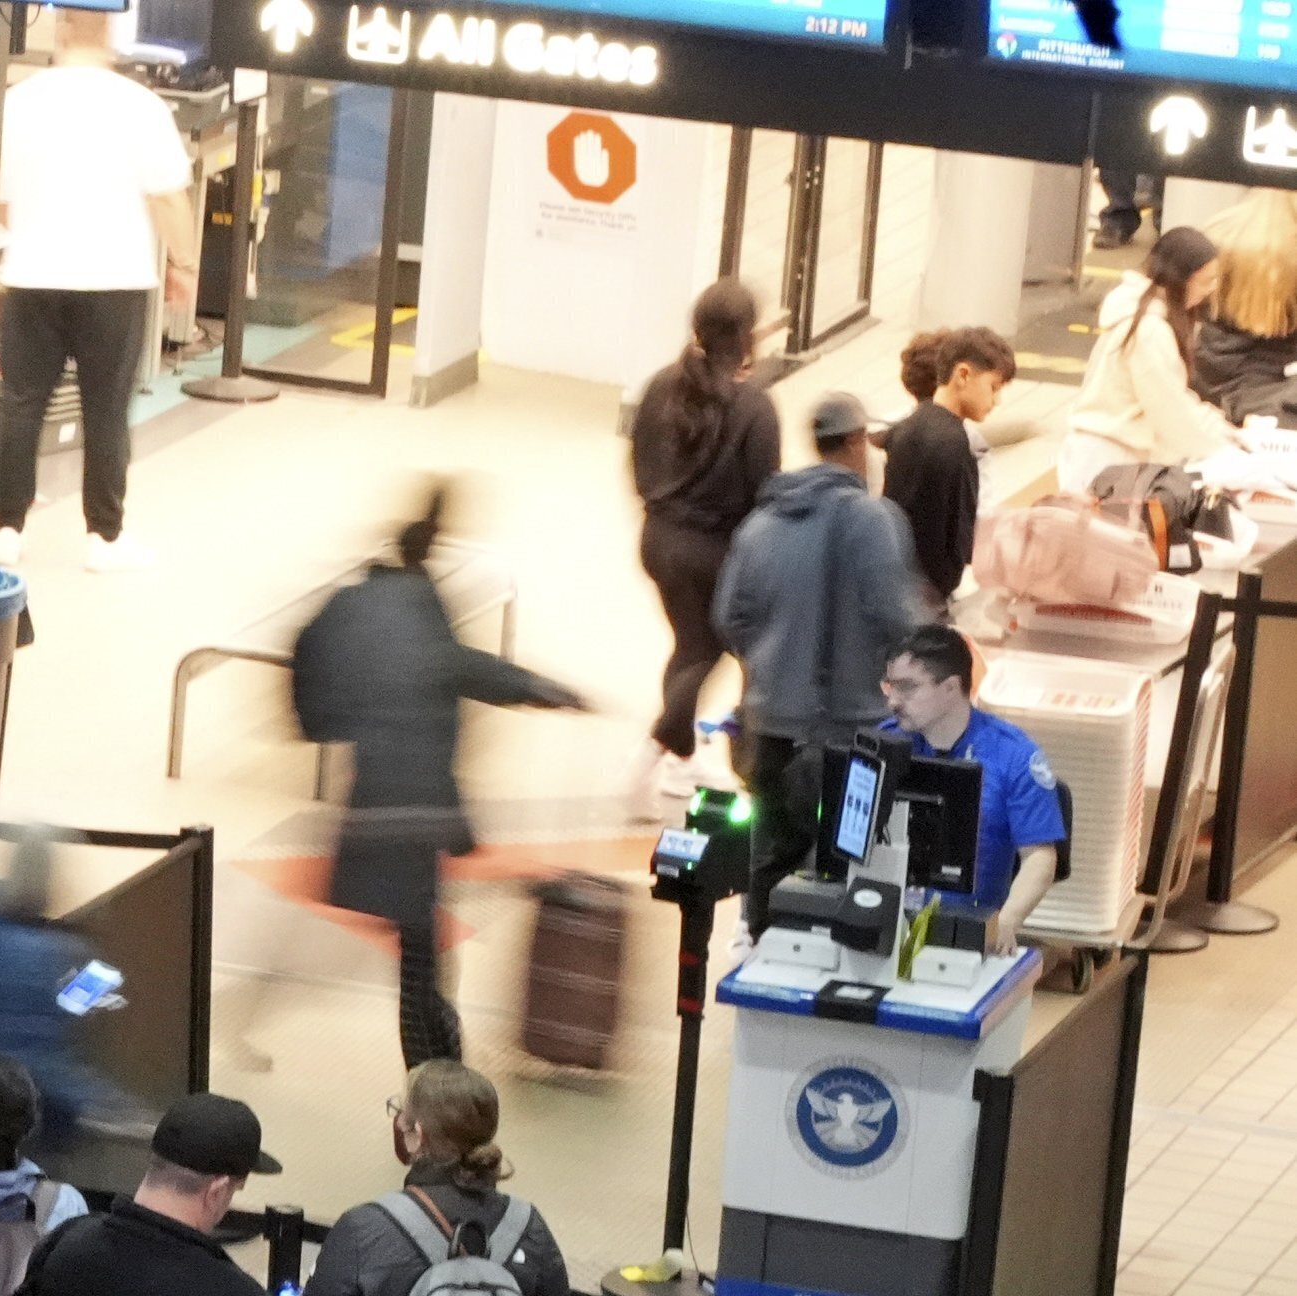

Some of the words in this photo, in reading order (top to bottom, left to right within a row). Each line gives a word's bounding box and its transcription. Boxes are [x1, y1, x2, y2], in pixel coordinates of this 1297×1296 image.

[418, 13, 496, 67] All
[503, 22, 659, 86] Gates
[842, 19, 868, 38] PM
